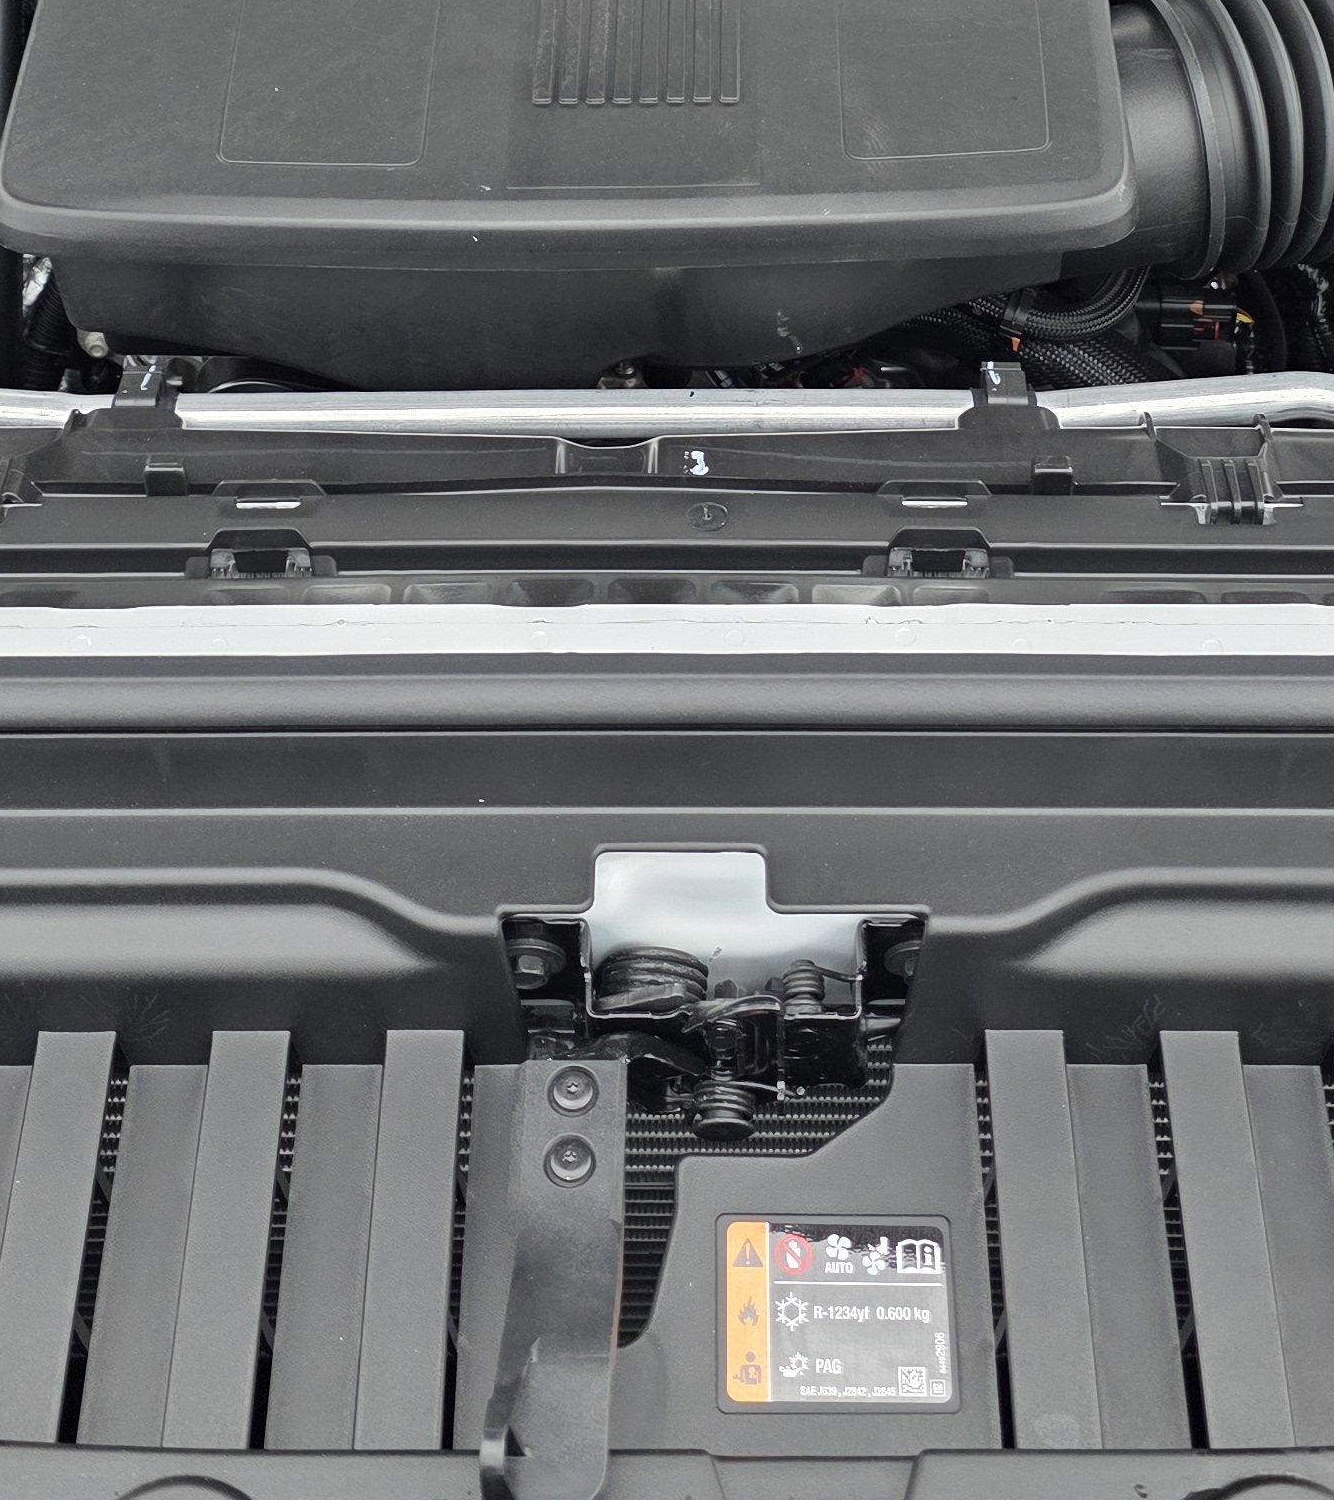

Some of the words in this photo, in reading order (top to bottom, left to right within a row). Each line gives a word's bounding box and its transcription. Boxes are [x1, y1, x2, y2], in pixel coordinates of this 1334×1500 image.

[824, 1261, 854, 1274] AUTO
[813, 1305, 869, 1323] R-1234yf
[875, 1306, 911, 1321] 0.600
[913, 1306, 930, 1324] kg
[815, 1358, 843, 1375] PAG
[799, 1385, 817, 1396] SAE
